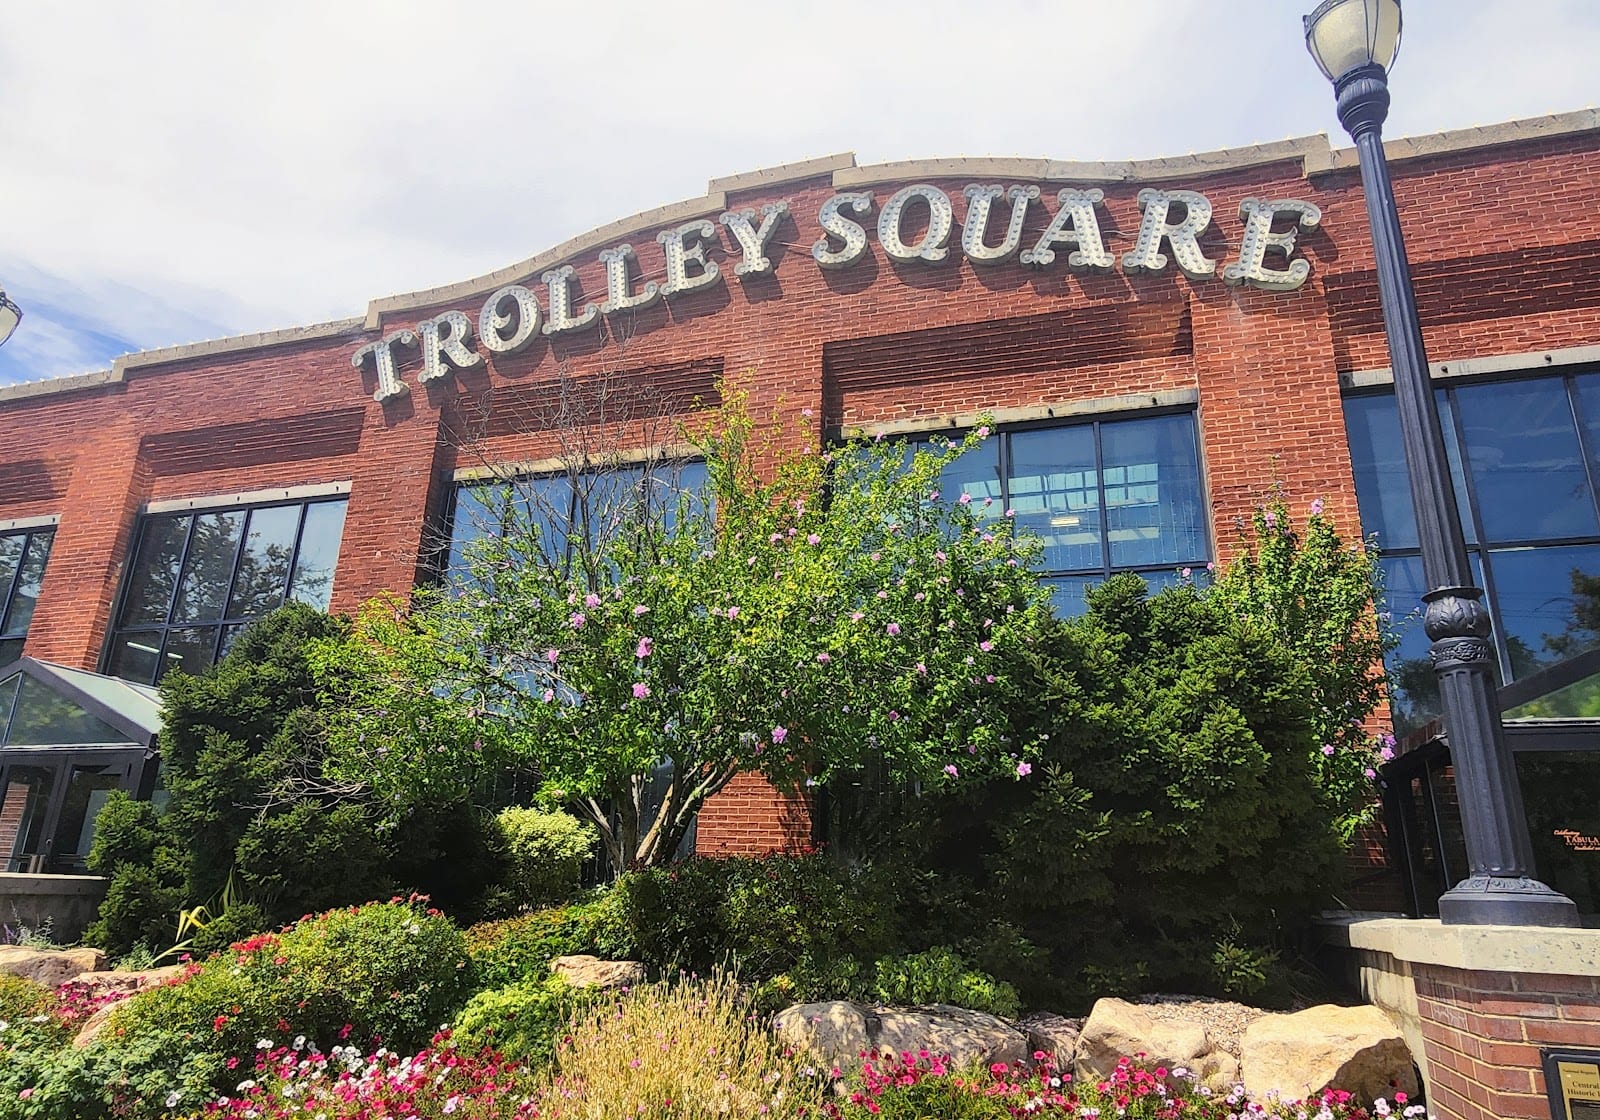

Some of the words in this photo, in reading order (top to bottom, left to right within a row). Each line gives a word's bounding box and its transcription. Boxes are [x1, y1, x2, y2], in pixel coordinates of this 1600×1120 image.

[351, 201, 789, 402] TROLLEY
[812, 184, 1321, 290] SQUARE
[1564, 835, 1600, 843] TABULA
[1572, 1081, 1600, 1089] Central
[1567, 1088, 1596, 1097] Historic
